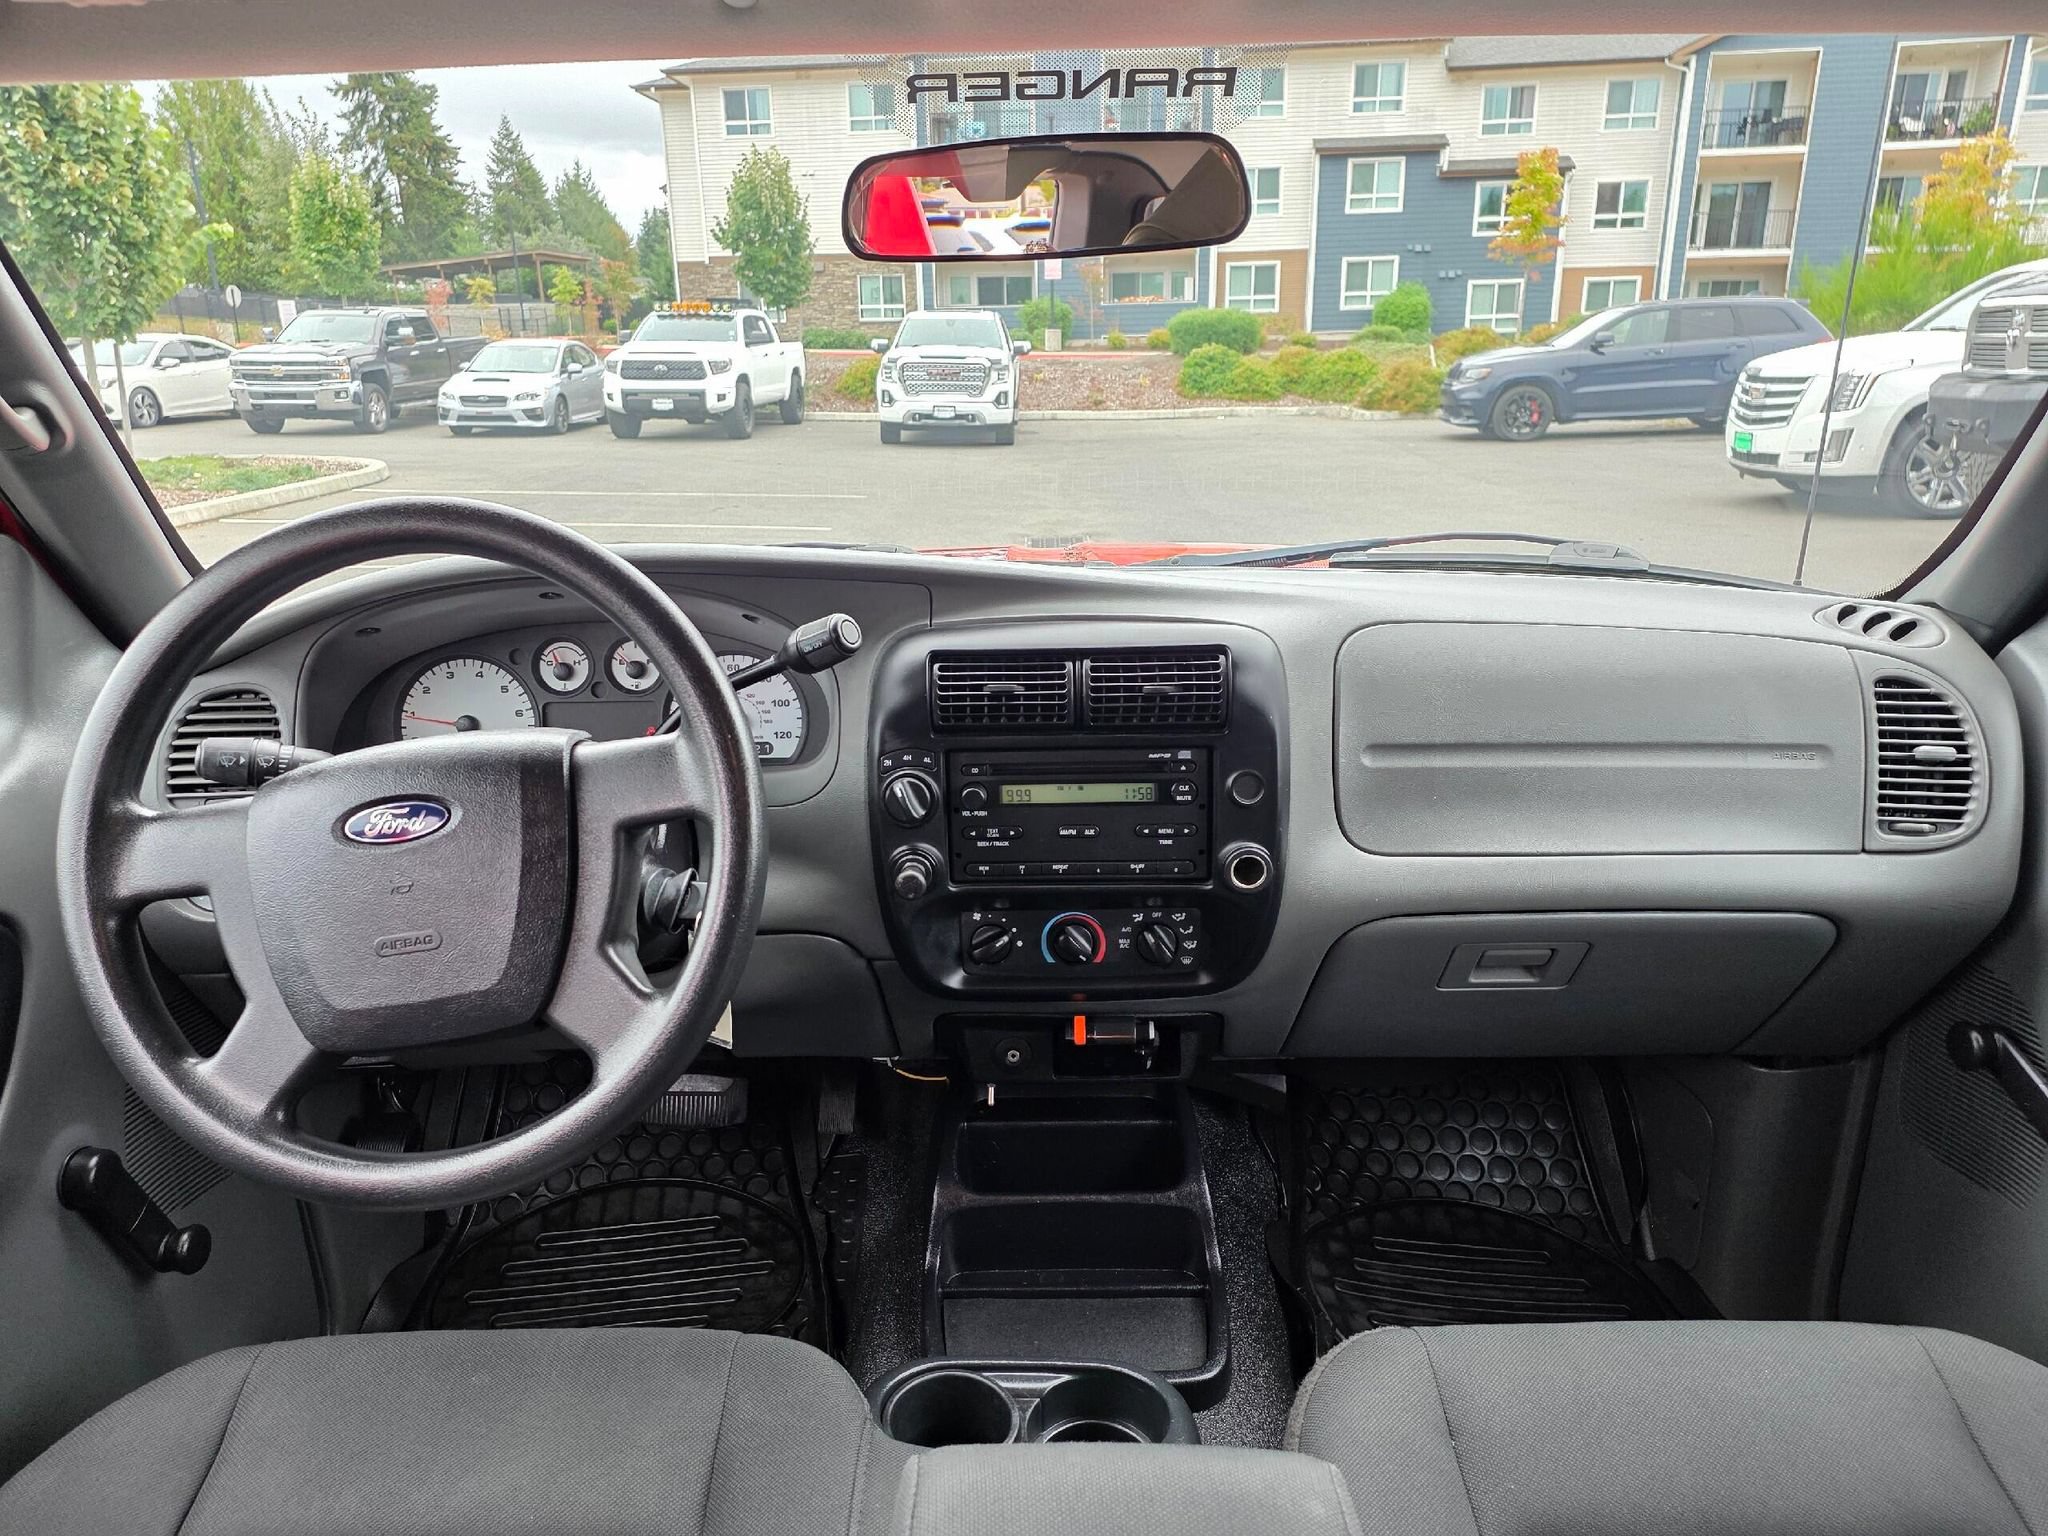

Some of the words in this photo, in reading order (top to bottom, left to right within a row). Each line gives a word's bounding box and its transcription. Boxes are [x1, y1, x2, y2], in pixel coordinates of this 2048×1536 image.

[726, 664, 740, 672] 60
[446, 671, 455, 680] 3
[475, 671, 484, 679] 4
[422, 686, 431, 695] 2
[501, 685, 509, 694] 5
[771, 699, 790, 707] 100
[514, 709, 524, 718] 6
[773, 731, 792, 739] 120
[1772, 751, 1816, 761] AIRBAG
[364, 807, 426, 837] Ford
[380, 934, 434, 951] AIRBAG
